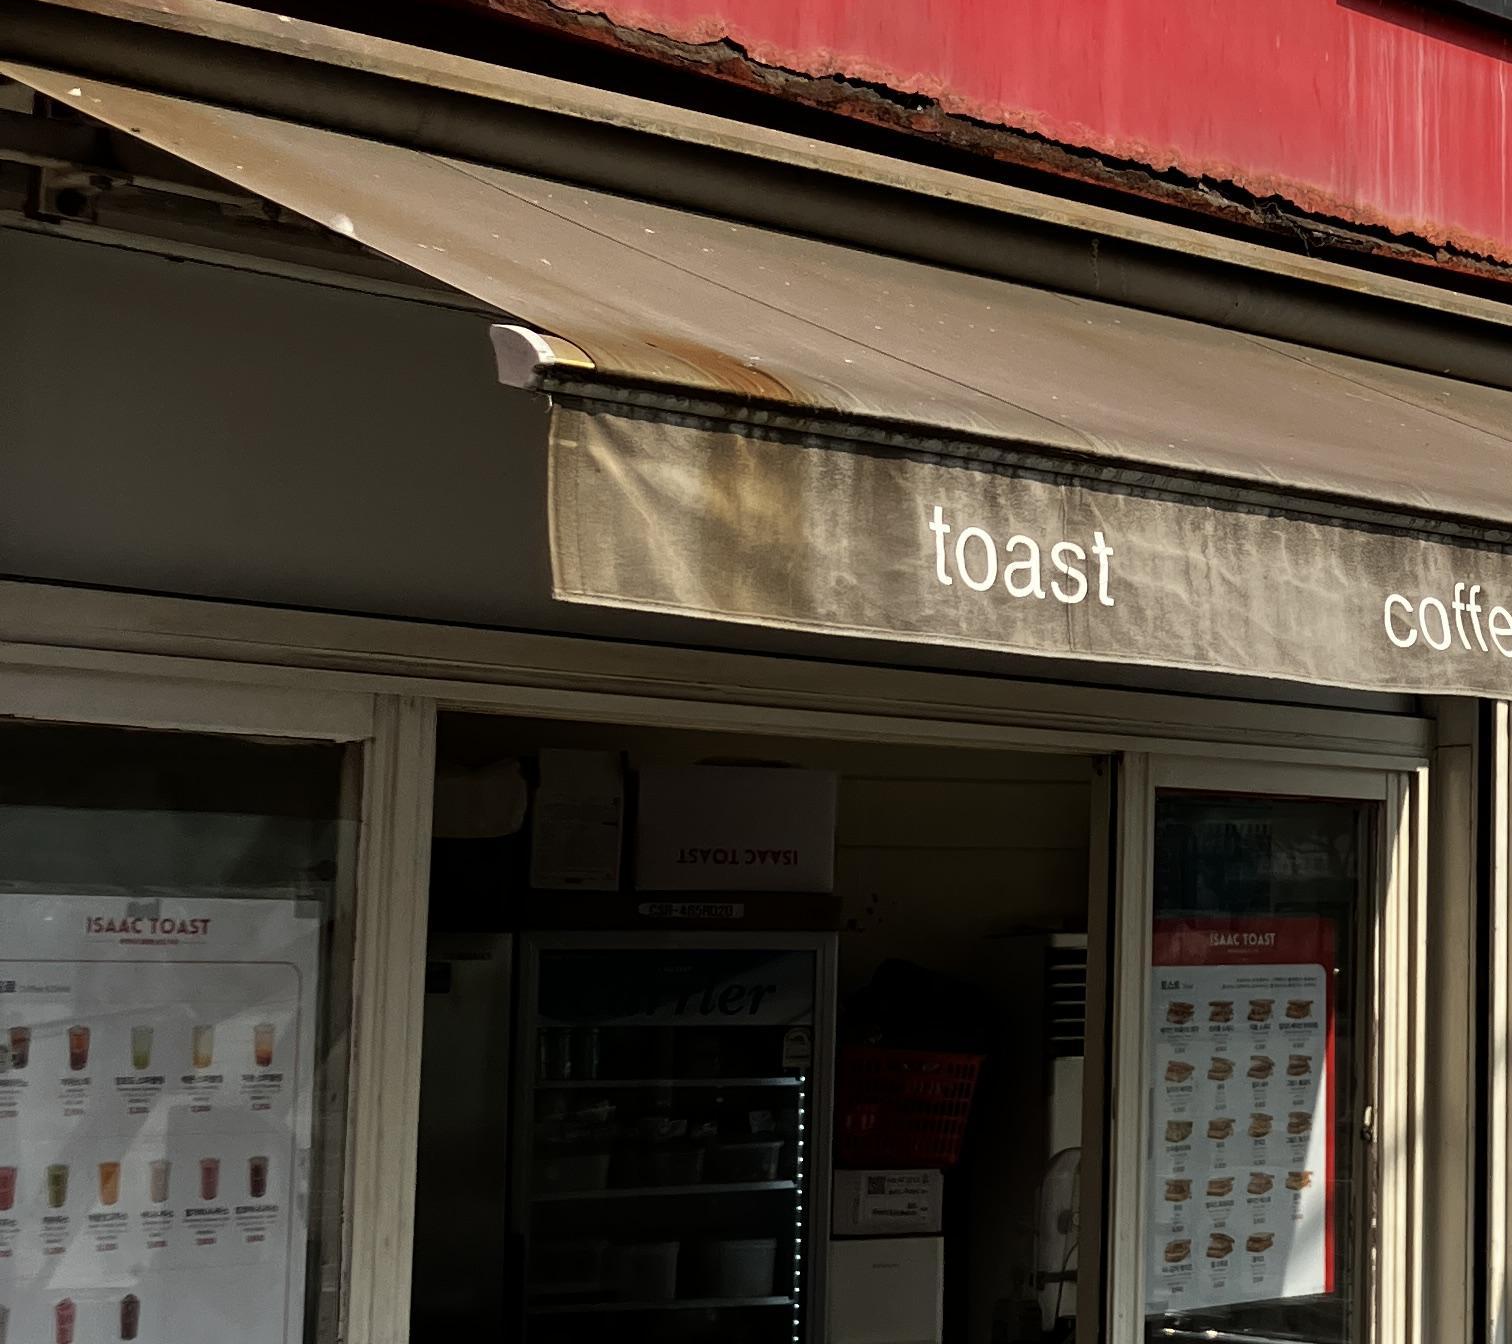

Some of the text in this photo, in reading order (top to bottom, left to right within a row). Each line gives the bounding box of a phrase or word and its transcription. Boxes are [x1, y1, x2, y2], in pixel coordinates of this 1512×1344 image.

[928, 505, 1116, 607] toast
[86, 916, 212, 936] ISAAC TOAST
[1209, 931, 1276, 947] ISAAC TOAST
